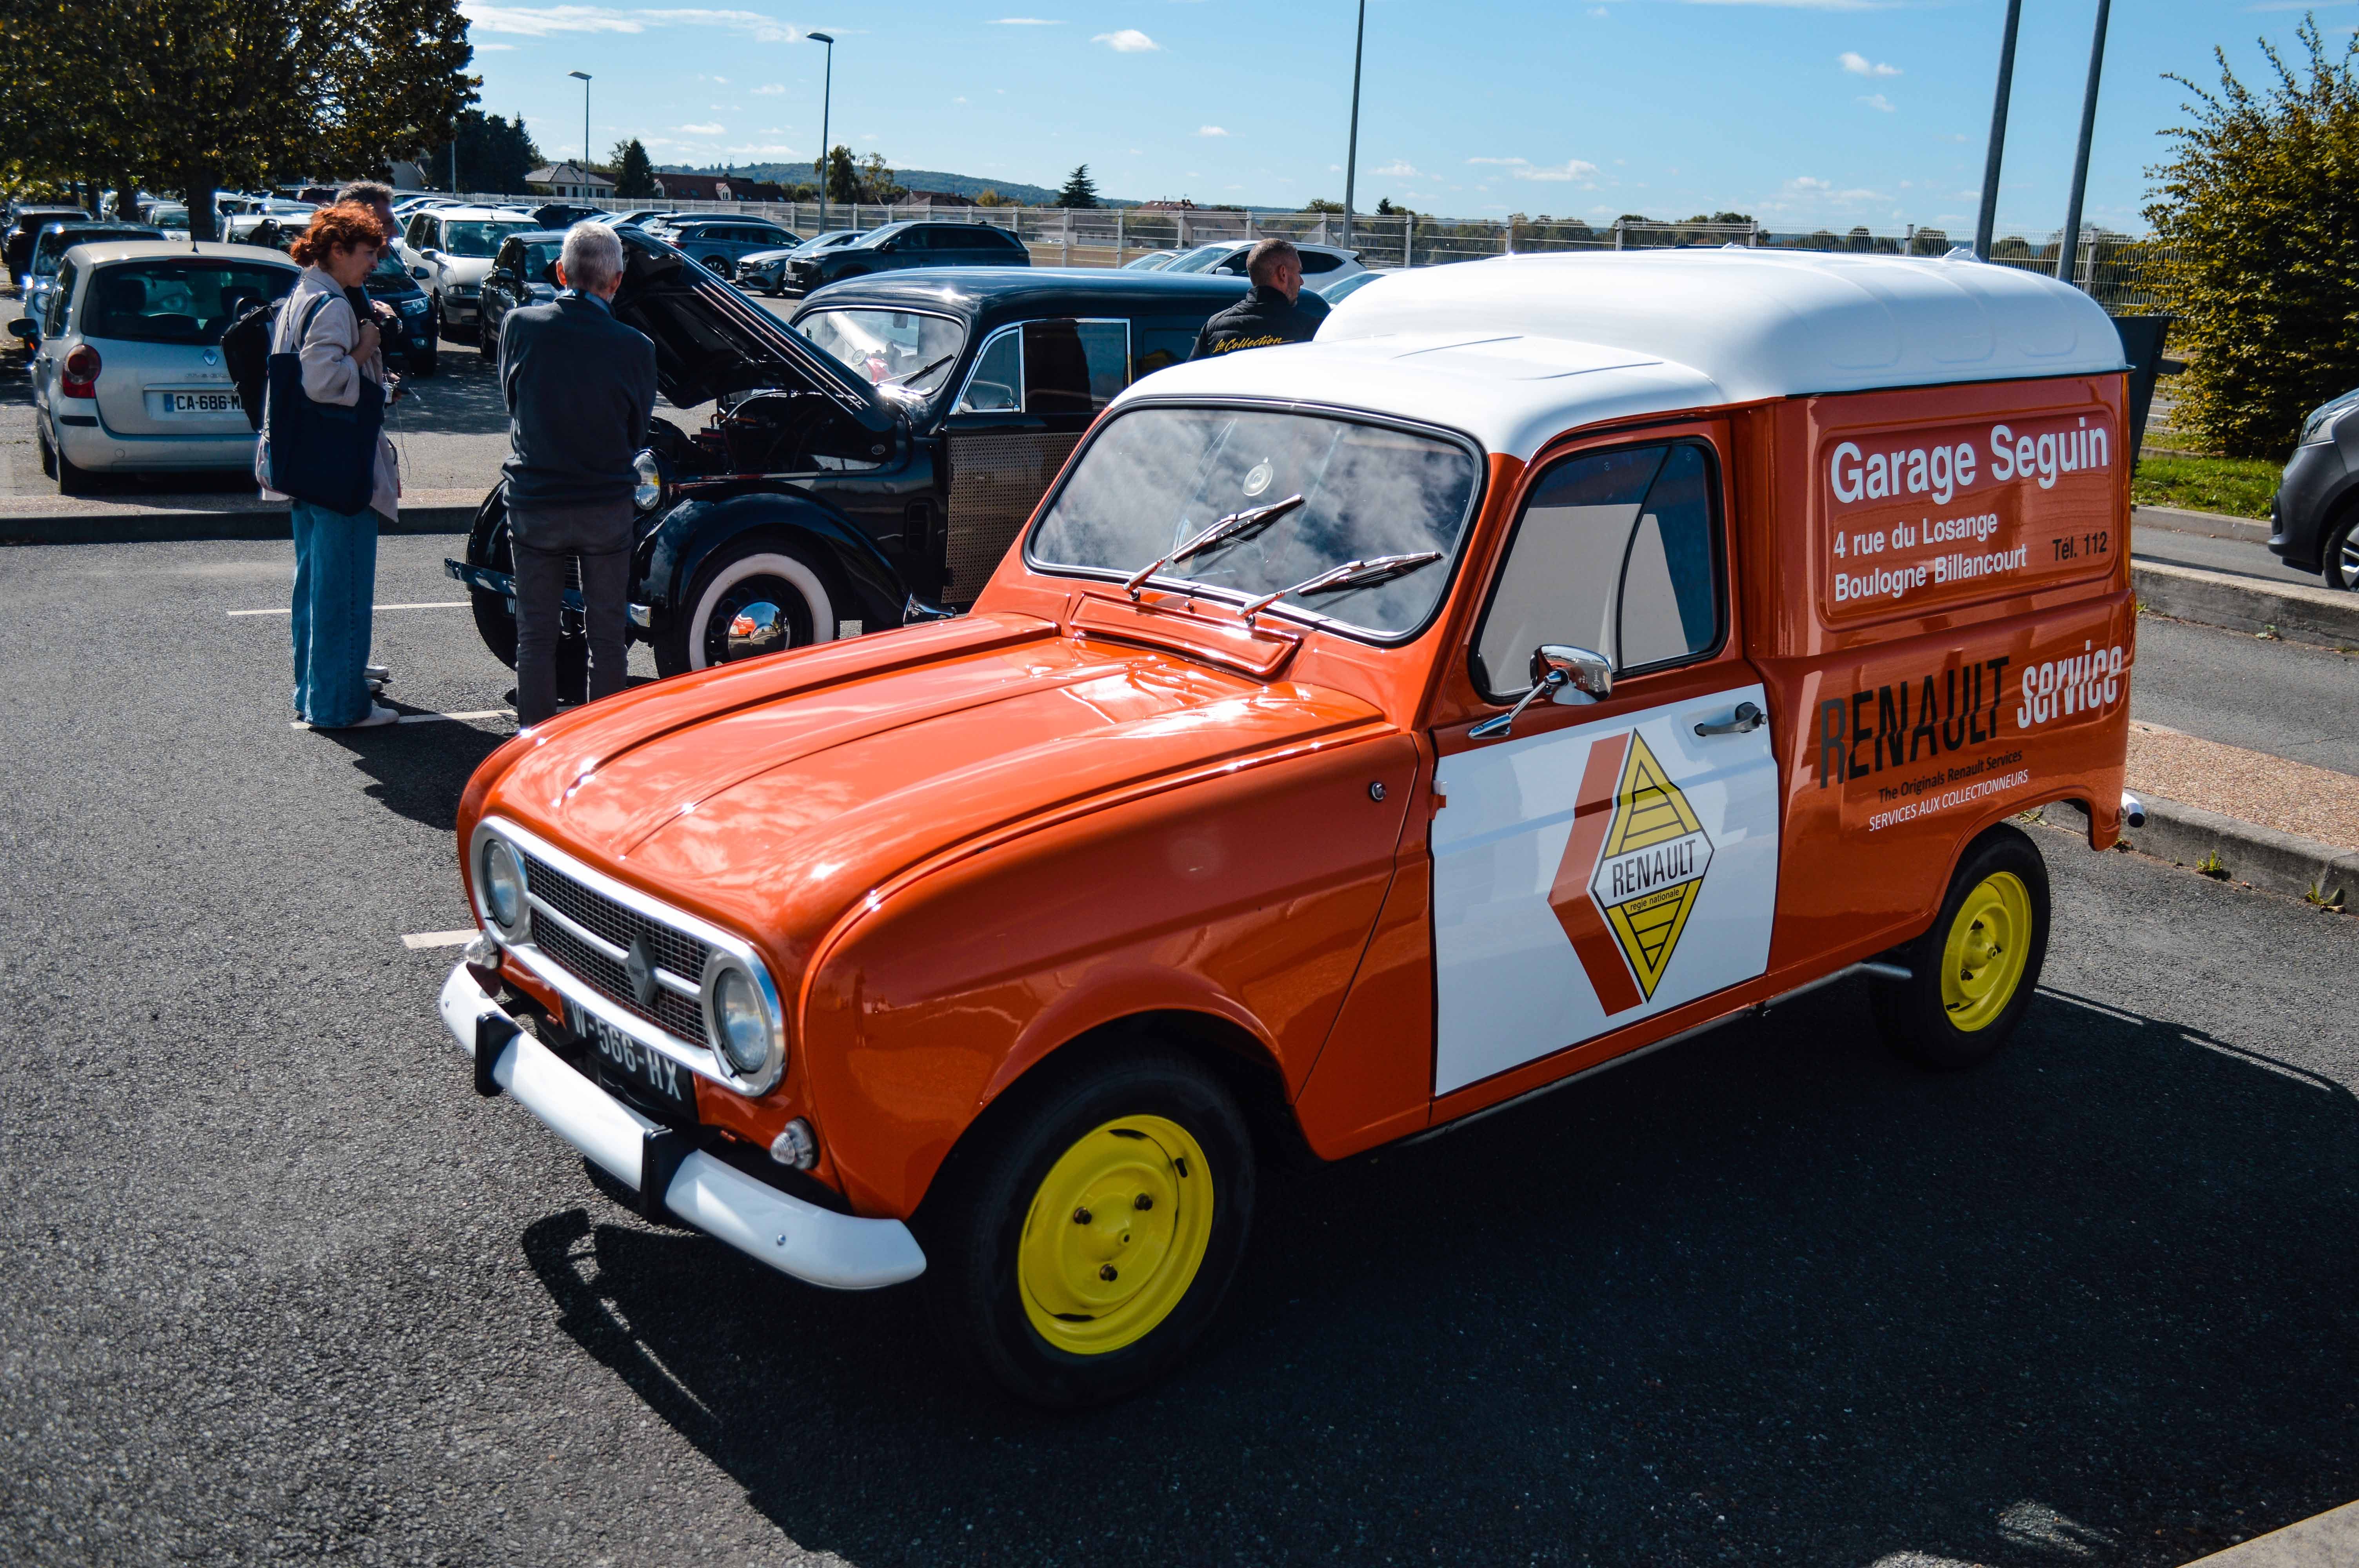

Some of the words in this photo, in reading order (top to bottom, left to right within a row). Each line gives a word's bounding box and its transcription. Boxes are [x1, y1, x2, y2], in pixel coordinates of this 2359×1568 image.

[1212, 339, 1226, 353] La
[1224, 335, 1294, 352] Collection
[176, 395, 245, 410] CA-686-M
[1831, 442, 1976, 505] Garage
[1990, 417, 2108, 489] Seguin
[1834, 531, 1846, 559] 4
[1853, 530, 1885, 556] rue
[1892, 521, 1915, 549] du
[1923, 513, 1998, 544] Losange
[2052, 536, 2077, 561] Tél.
[2084, 531, 2108, 555] 112
[1835, 565, 1926, 602] Boulogne
[1935, 543, 2027, 583] Billancourt
[1820, 655, 2010, 789] RENAULT
[2017, 639, 2122, 729] service
[1869, 803, 1917, 832] SERVICES
[1918, 796, 1940, 816] AUX
[1942, 769, 2028, 808] COLLECTIONNEURS
[1878, 788, 1898, 803] The
[1901, 771, 1945, 796] Originals
[1948, 759, 1984, 782] Renault
[1986, 750, 2023, 771] Services
[1612, 839, 1696, 898] RENAULT
[1630, 899, 1647, 911] regie
[1649, 888, 1679, 905] nationale
[571, 1000, 682, 1101] W-566-HX
